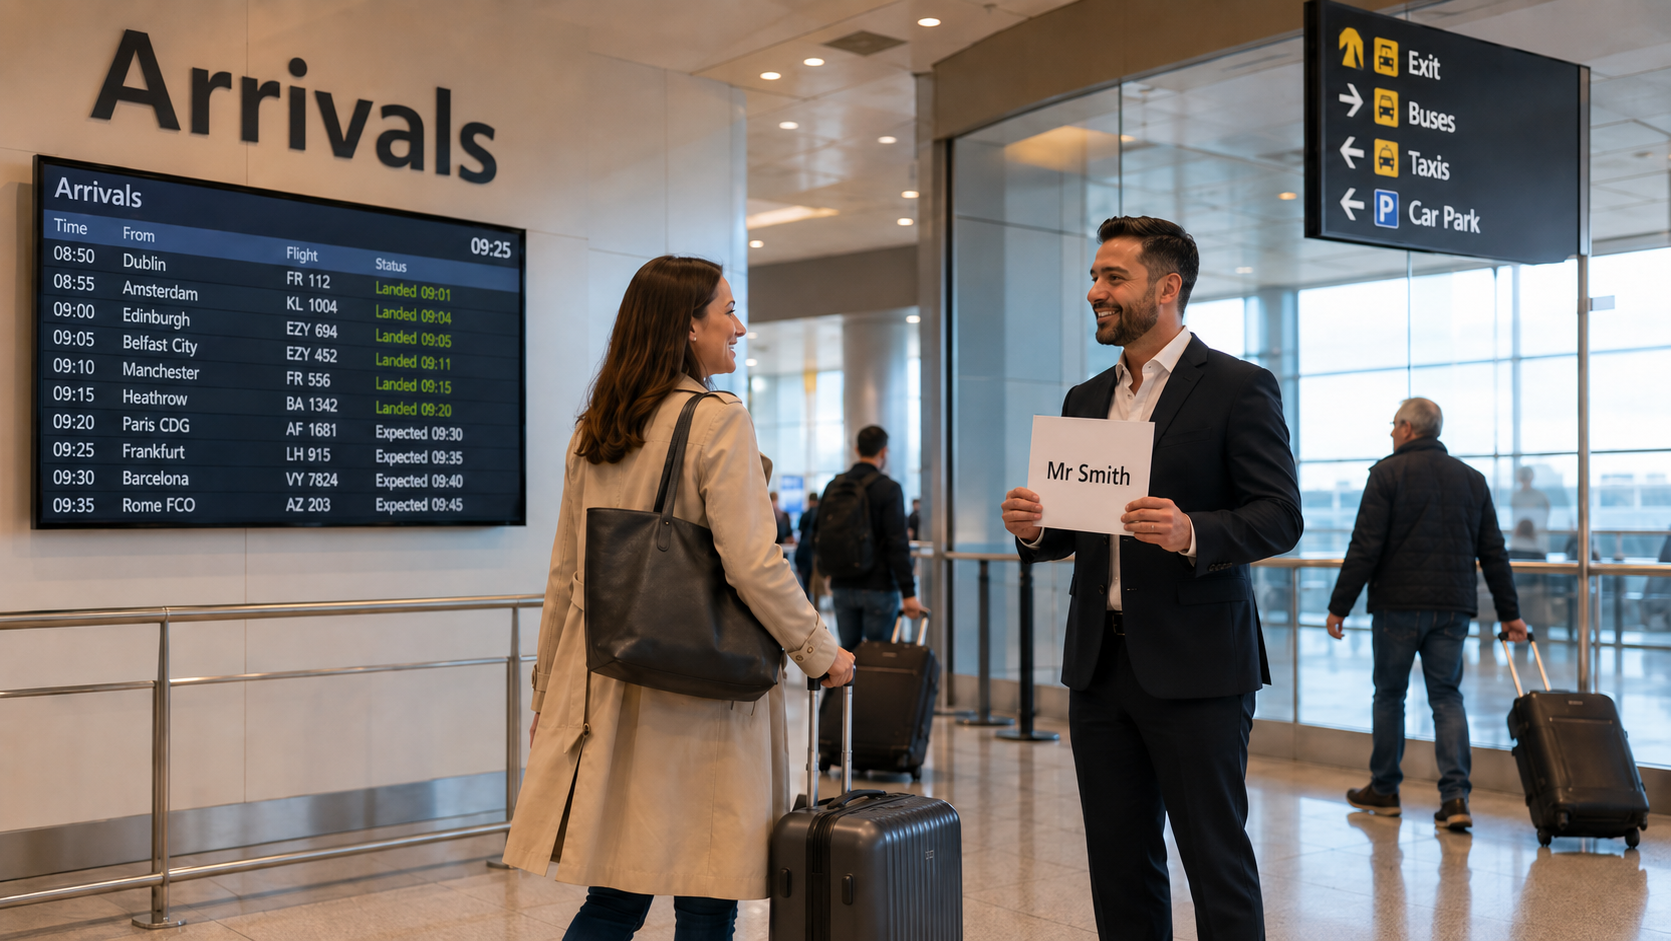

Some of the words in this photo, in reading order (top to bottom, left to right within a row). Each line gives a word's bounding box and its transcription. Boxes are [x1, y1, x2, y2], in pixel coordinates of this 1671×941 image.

[1409, 51, 1440, 80] Exit
[90, 29, 497, 185] Arrivals
[1409, 101, 1455, 133] Buses
[1408, 151, 1450, 180] Taxis
[55, 177, 141, 207] Arrivals
[1380, 195, 1393, 222] P
[1409, 201, 1438, 227] Car
[1444, 206, 1480, 233] Park
[54, 218, 87, 234] Time
[124, 227, 154, 242] From
[287, 246, 318, 263] Flight
[376, 258, 407, 272] Status
[471, 238, 511, 258] 09:25
[54, 246, 94, 263] 08:50
[124, 253, 165, 271] Dublin
[287, 271, 303, 285] FR
[309, 274, 330, 288] 112
[376, 281, 416, 297] Landed
[421, 286, 450, 301] 09:01
[54, 274, 94, 291] 08:55
[123, 281, 197, 301] Amsterdam
[287, 296, 303, 310] KL
[309, 298, 337, 313] 1004
[376, 305, 416, 321] Landed
[421, 310, 451, 324] 09:04
[54, 302, 94, 319] 09:00
[124, 308, 189, 329] Edinburgh
[287, 321, 310, 336] EZY
[316, 324, 337, 338] 694
[376, 329, 417, 344] Landed
[421, 333, 451, 347] 09:05
[54, 330, 94, 346] 09:05
[124, 335, 167, 351] Belfast
[173, 338, 197, 356] City
[287, 346, 310, 361] EZY
[315, 348, 337, 362] 452
[376, 353, 416, 368] Landed
[421, 356, 450, 370] 09:11
[54, 358, 94, 374] 09:10
[123, 362, 199, 379] Manchester
[287, 371, 303, 385] FR
[309, 373, 330, 387] 556
[376, 377, 417, 391] Landed
[421, 379, 451, 394] 09:15
[54, 386, 94, 402] 09:15
[124, 389, 187, 405] Heathrow
[287, 396, 304, 410] BA
[309, 398, 337, 412] 1342
[376, 401, 417, 415] Landed
[421, 403, 451, 417] 09:20
[54, 414, 94, 429] 09:20
[123, 417, 155, 431] Paris
[160, 418, 189, 432] CDG
[286, 422, 303, 435] AF
[309, 423, 336, 436] 1681
[376, 425, 428, 441] Expected
[432, 427, 463, 441] 09:30
[54, 442, 94, 457] 09:25
[123, 444, 185, 459] Frankfurt
[287, 447, 303, 461] LH
[308, 448, 330, 461] 915
[376, 449, 427, 466] Expected
[432, 450, 463, 464] 09:35
[54, 470, 94, 485] 09:30
[123, 471, 188, 485] Barcelona
[286, 472, 304, 486] VY
[309, 473, 338, 486] 7824
[376, 473, 427, 490] Expected
[432, 474, 463, 488] 09:40
[1048, 461, 1073, 480] Mr
[1078, 464, 1130, 485] Smith
[53, 498, 94, 512] 09:35
[123, 498, 162, 512] Rome
[167, 498, 195, 512] FCO
[286, 498, 303, 511] AZ
[308, 498, 330, 511] 203
[376, 498, 428, 515] Expected
[432, 498, 463, 511] 09:45
